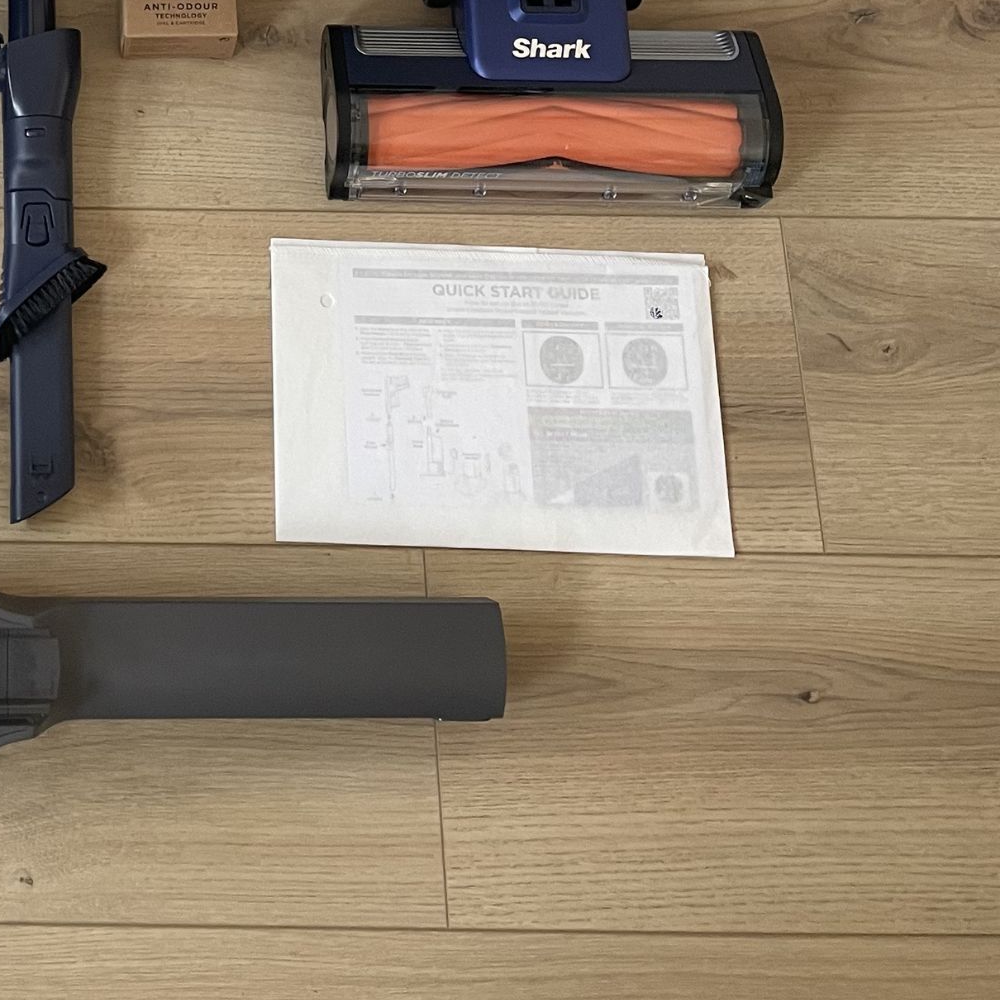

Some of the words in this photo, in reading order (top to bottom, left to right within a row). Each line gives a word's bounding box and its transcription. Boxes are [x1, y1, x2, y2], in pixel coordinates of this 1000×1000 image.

[143, 2, 218, 11] ANTI-ODOUR
[511, 37, 592, 60] Shark
[432, 283, 486, 297] QUICK
[490, 285, 543, 299] START
[547, 286, 600, 300] GUIDE
